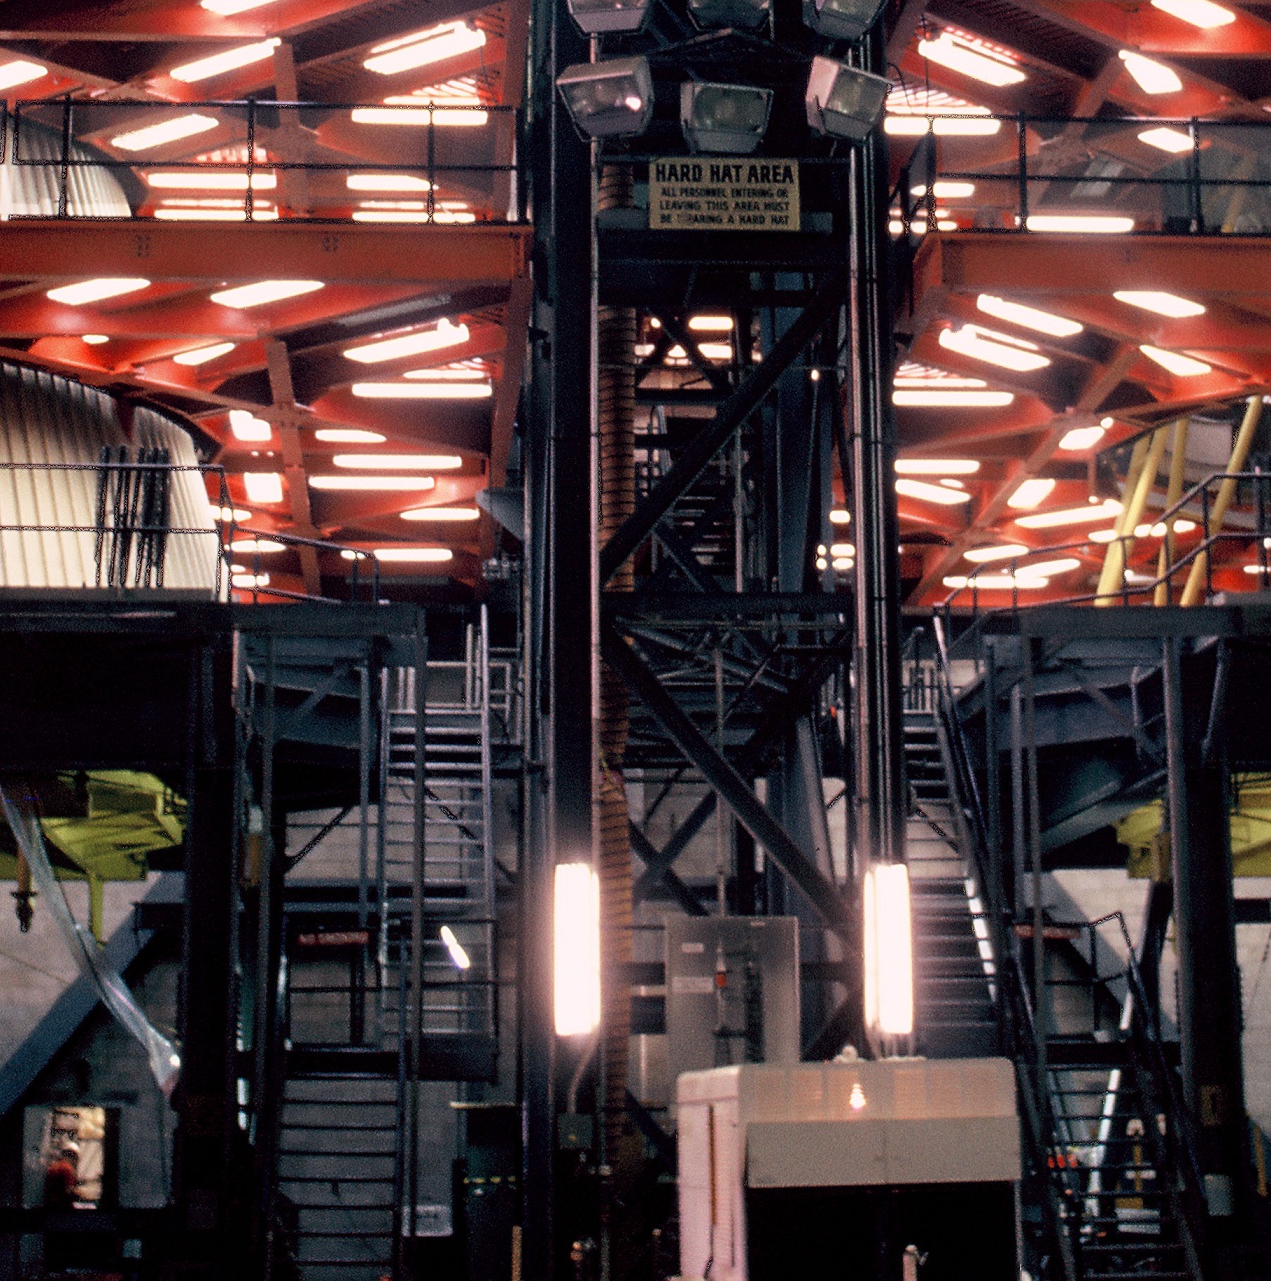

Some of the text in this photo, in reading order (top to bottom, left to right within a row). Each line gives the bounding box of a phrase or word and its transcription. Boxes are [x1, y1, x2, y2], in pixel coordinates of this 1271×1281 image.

[655, 163, 794, 184] HARD HAT AREA
[661, 187, 789, 198] ALL PERSONNEL ENTERING OR
[659, 200, 790, 211] LEAVING THIS AREA MUST
[660, 214, 790, 225] BE ARING A HARD HAT
